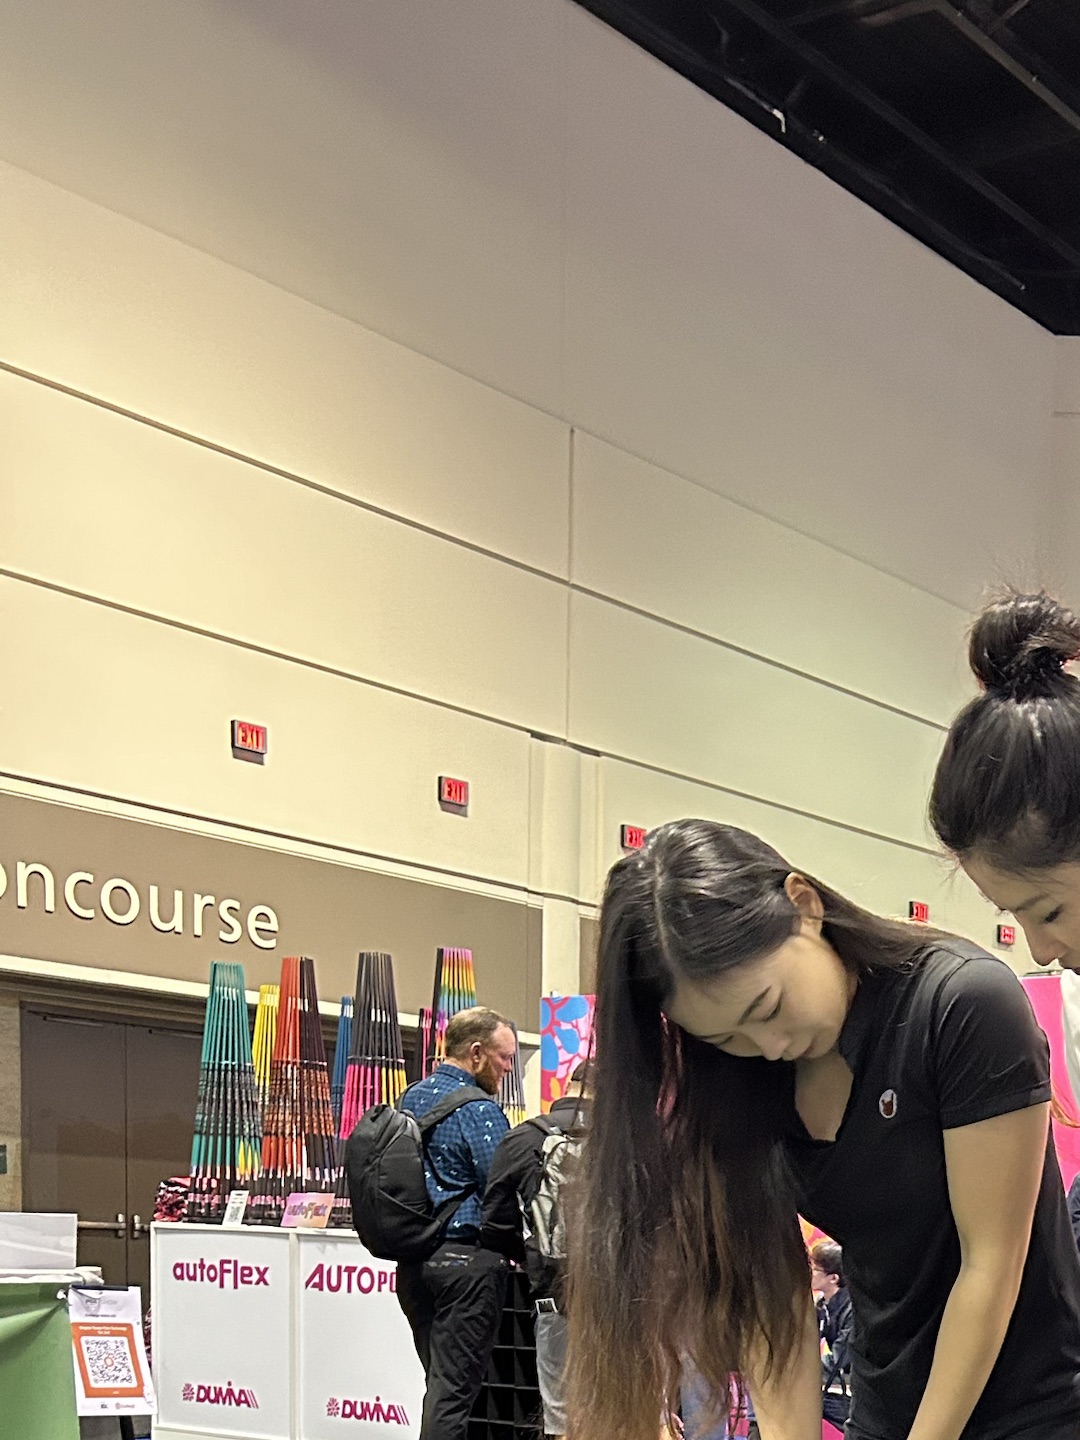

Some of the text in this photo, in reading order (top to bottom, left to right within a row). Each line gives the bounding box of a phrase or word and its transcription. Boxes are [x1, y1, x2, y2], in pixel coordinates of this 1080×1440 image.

[237, 723, 265, 750] EXIT
[443, 779, 467, 804] EXIT
[0, 860, 279, 949] ncourse
[172, 1258, 270, 1289] autoFlex
